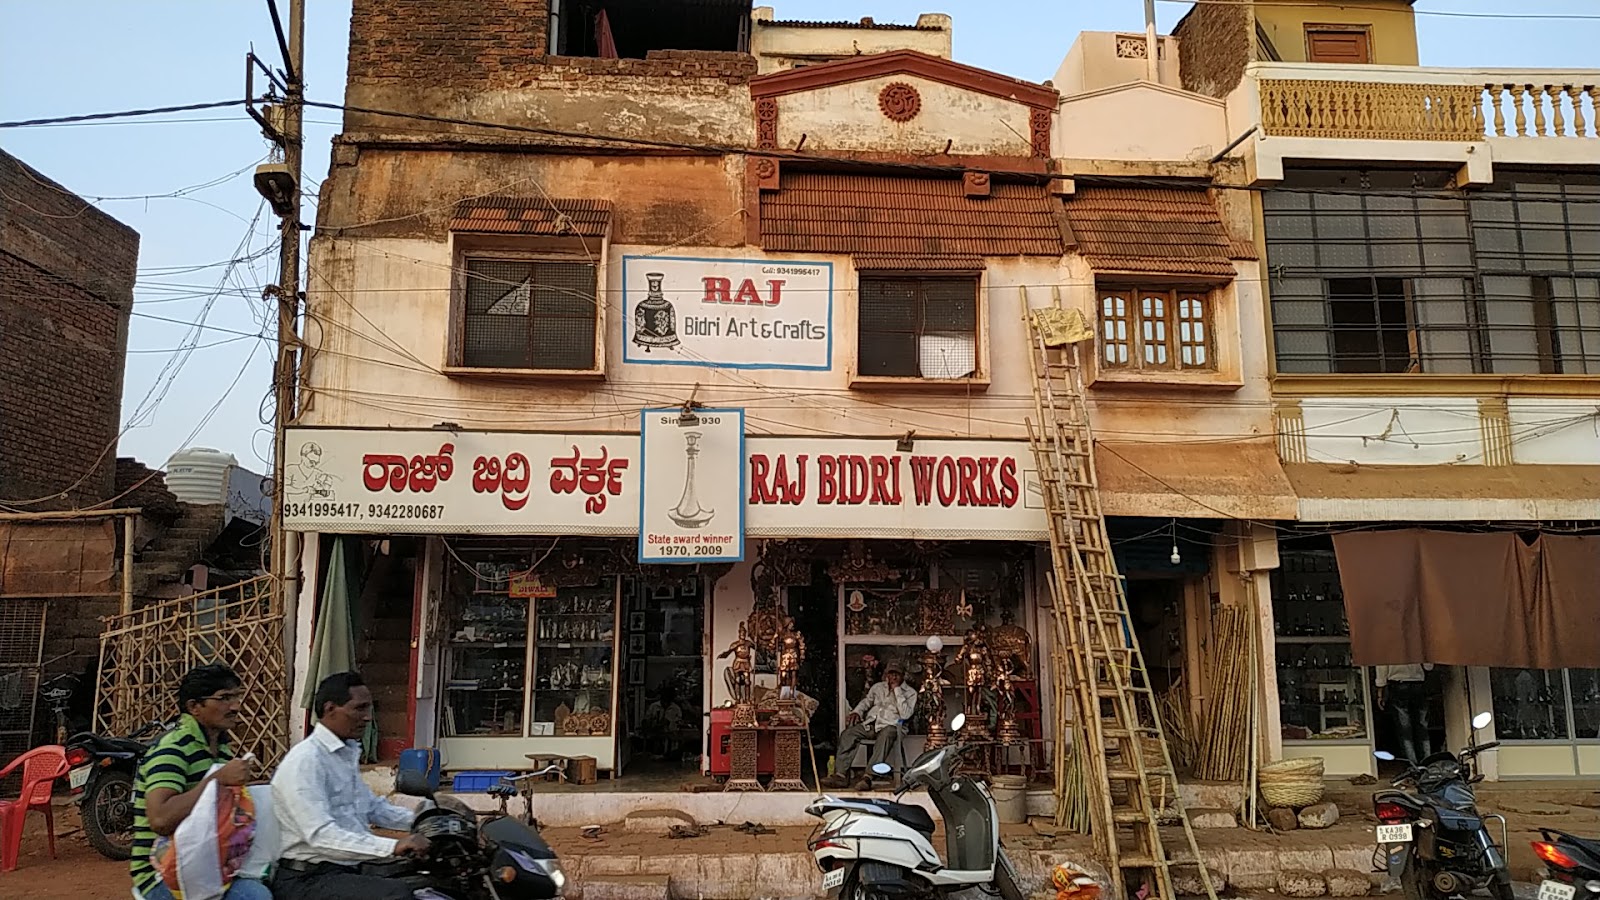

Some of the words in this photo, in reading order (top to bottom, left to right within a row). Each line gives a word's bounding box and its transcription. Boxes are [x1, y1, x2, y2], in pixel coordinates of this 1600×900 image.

[701, 276, 786, 307] RAJ
[684, 316, 720, 337] Bidri
[362, 442, 455, 493] ರಾಜ್
[472, 452, 531, 511] ಬಿದ್ರಿ
[749, 454, 809, 506] RAJ
[817, 454, 902, 506] BIDRI
[909, 455, 1019, 508] WORKS
[284, 503, 364, 520] 9341995417,
[368, 504, 445, 519] 9342280687
[648, 534, 671, 544] State
[673, 534, 701, 544] award
[703, 534, 734, 544] winner
[659, 545, 691, 556] 1970,
[694, 545, 723, 555] 2009
